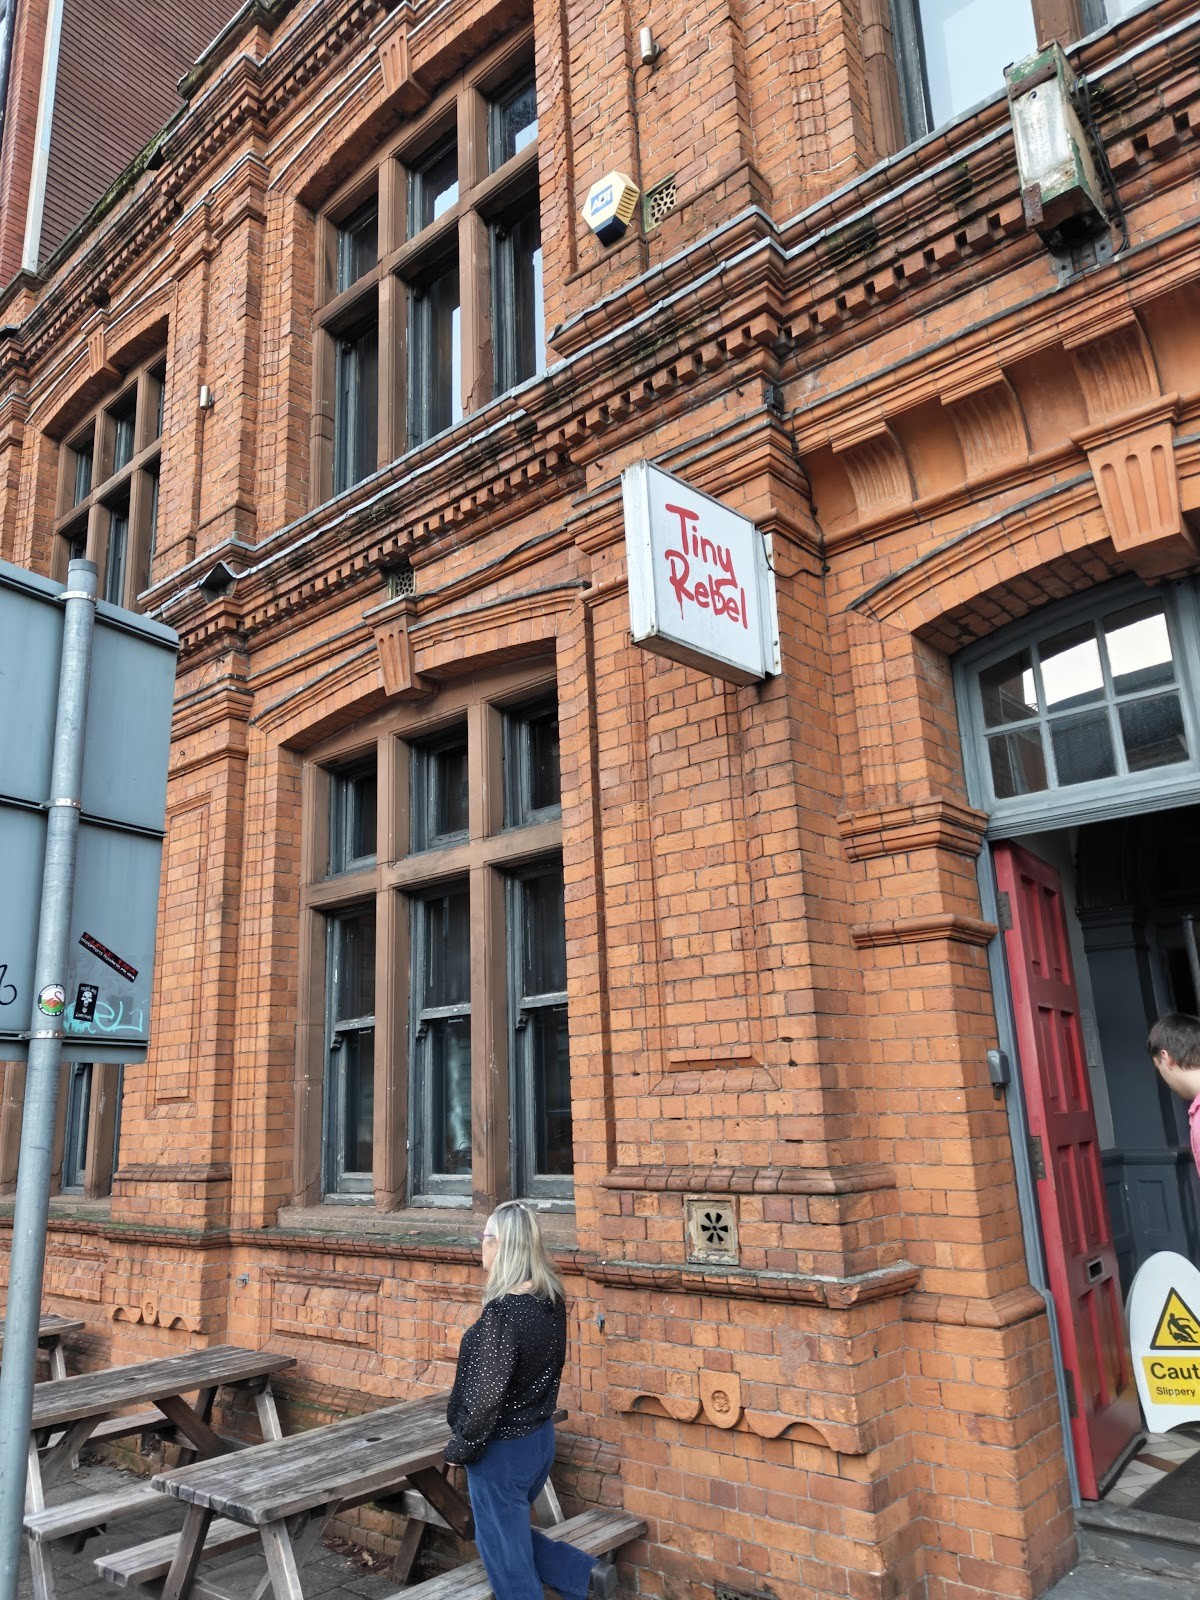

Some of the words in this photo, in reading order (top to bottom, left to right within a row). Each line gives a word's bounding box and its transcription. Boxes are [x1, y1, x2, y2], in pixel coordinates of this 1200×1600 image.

[665, 503, 738, 588] Tiny
[664, 549, 748, 629] Rebel
[1156, 1386, 1196, 1397] Slippery
